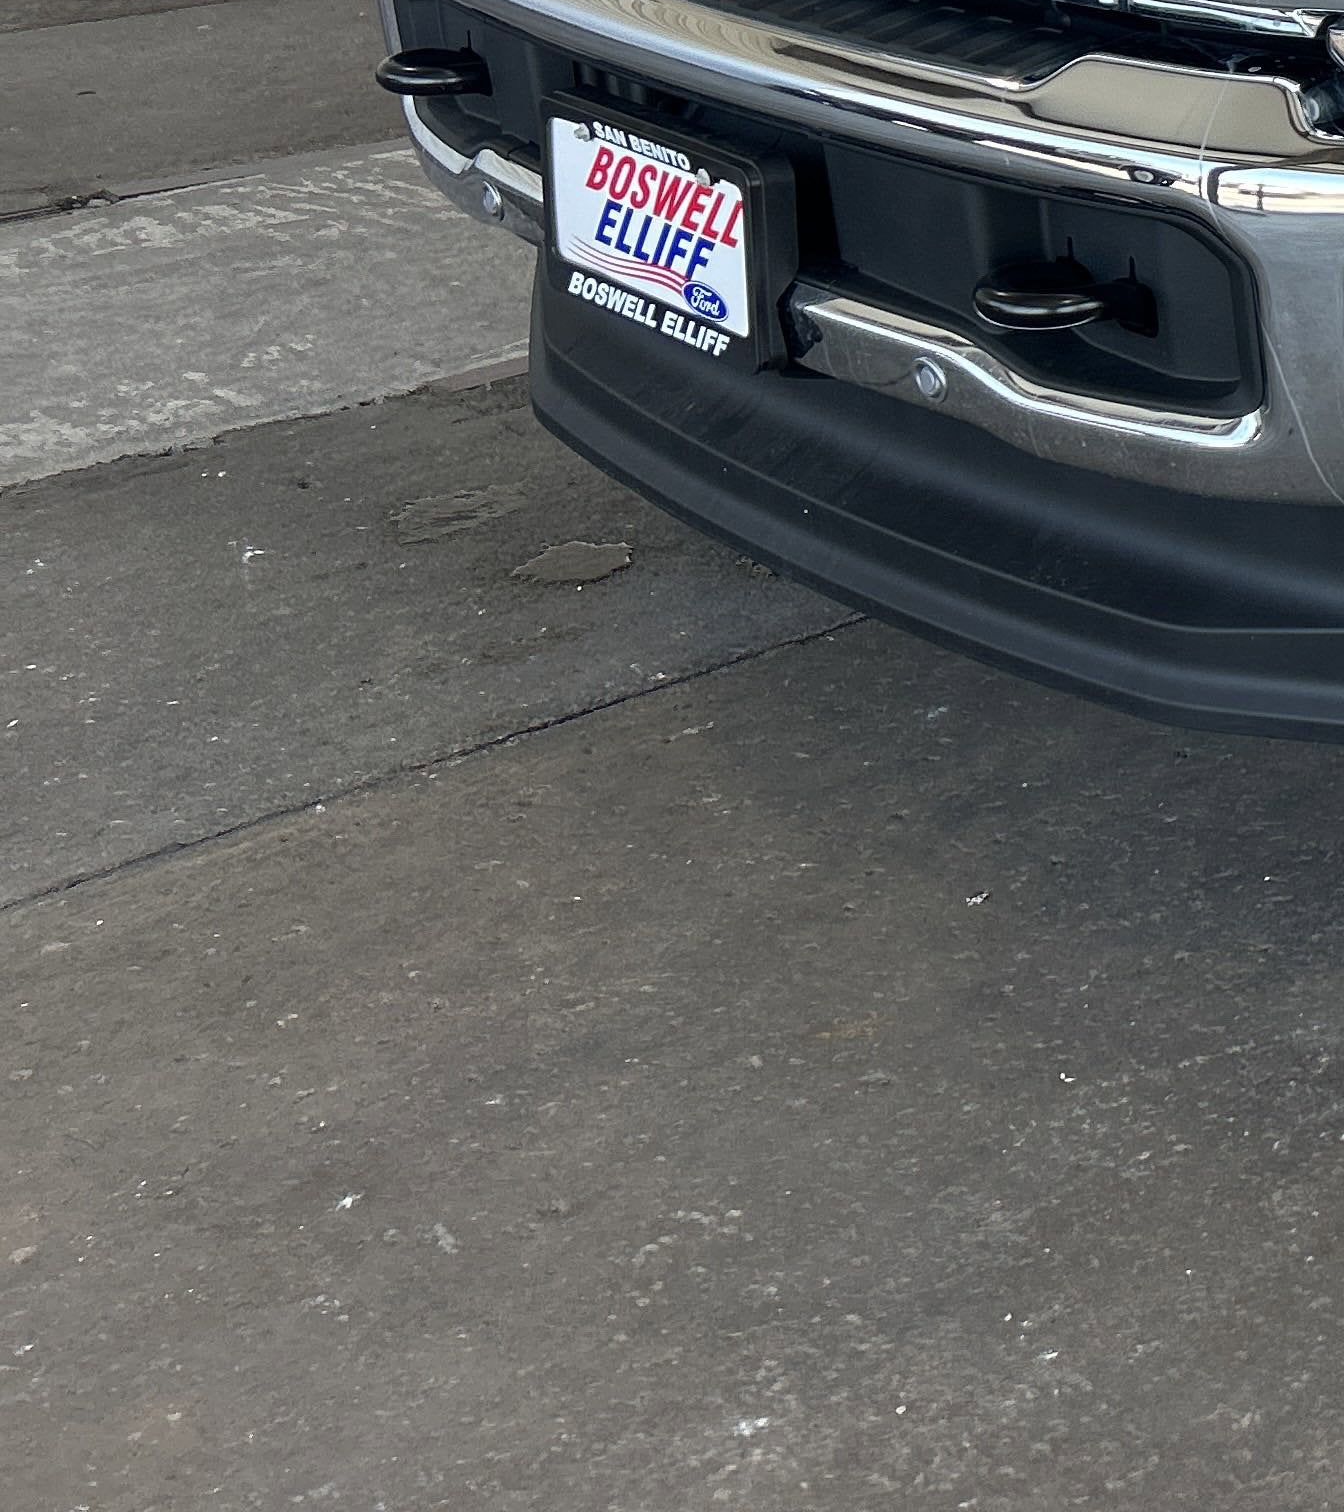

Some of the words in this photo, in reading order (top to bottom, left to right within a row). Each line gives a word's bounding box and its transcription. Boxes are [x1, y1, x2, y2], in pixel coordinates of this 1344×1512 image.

[593, 121, 628, 148] SAN
[631, 134, 690, 170] BENITO
[585, 146, 744, 248] BOSWELL
[595, 199, 716, 280] ELLIFF
[567, 271, 658, 328] BOSWELL
[660, 310, 731, 357] ELLIFF
[690, 287, 721, 317] Ford
